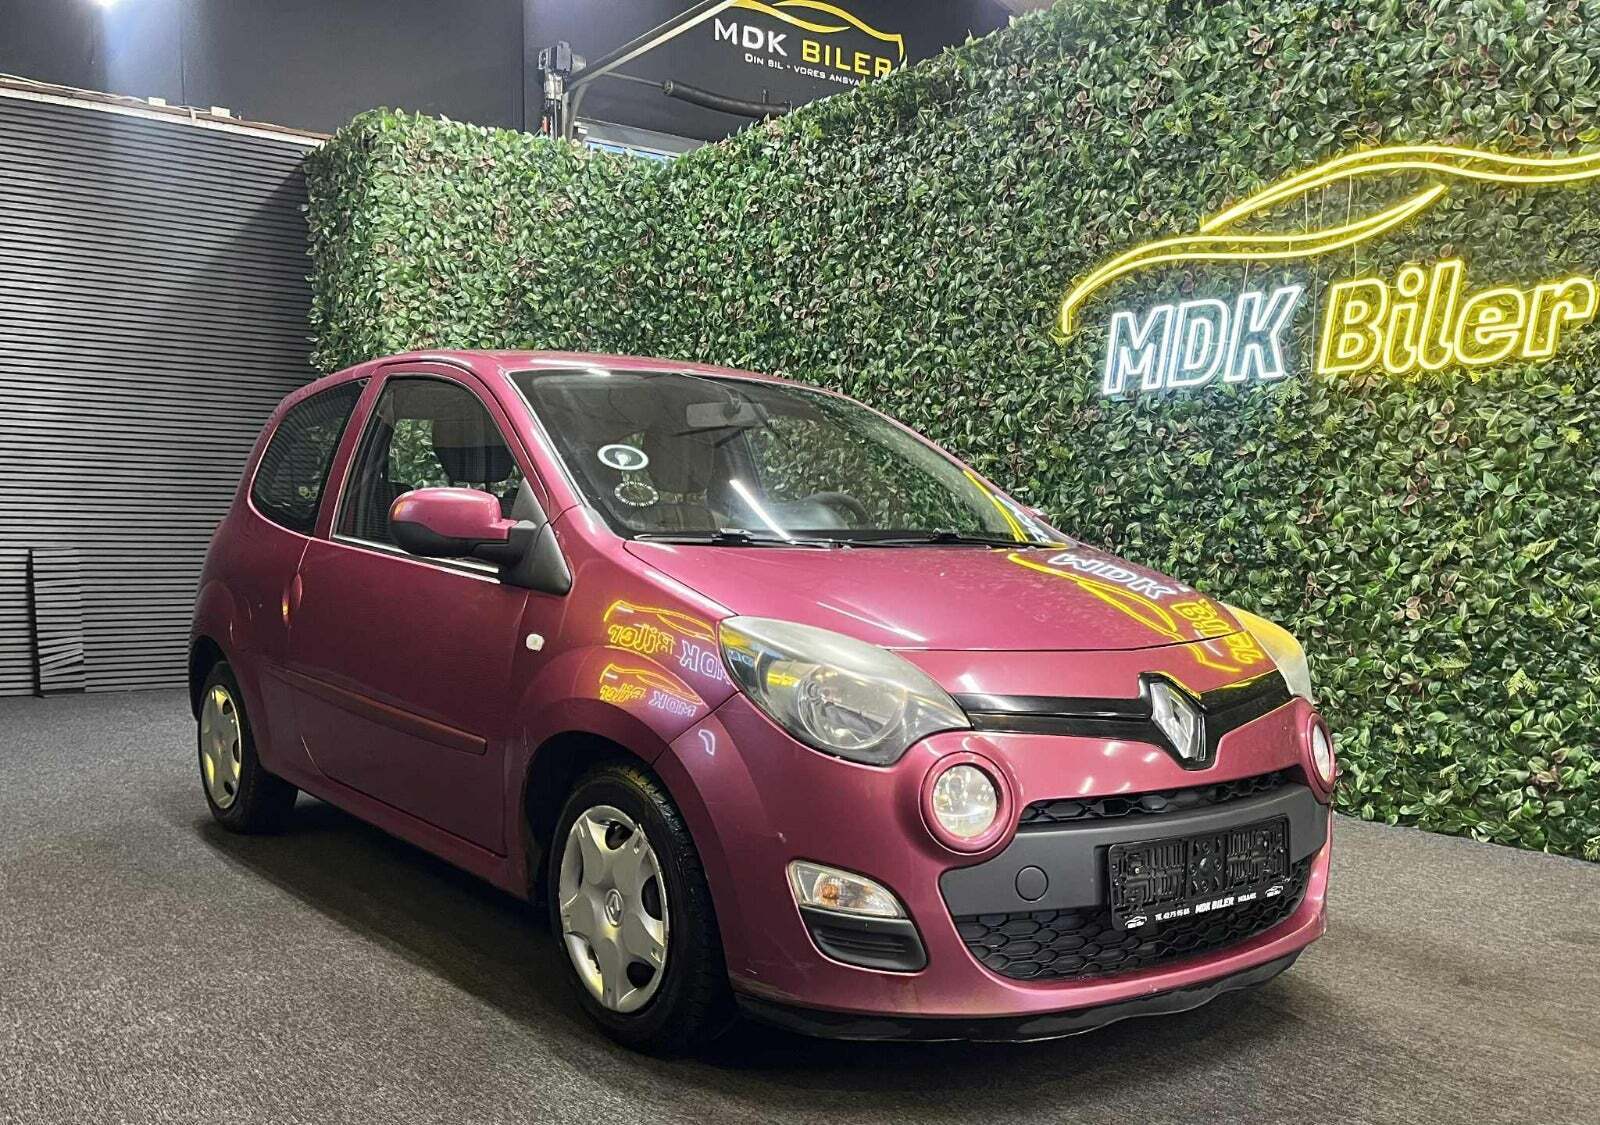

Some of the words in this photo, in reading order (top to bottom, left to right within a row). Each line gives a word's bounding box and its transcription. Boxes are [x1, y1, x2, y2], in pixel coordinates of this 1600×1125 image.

[714, 18, 788, 57] MDK
[802, 39, 892, 78] BILER
[744, 53, 764, 65] DIN
[768, 59, 783, 70] BIL
[794, 65, 826, 79] VORES
[829, 74, 860, 87] ANSVA
[1102, 284, 1304, 396] MDK
[1316, 257, 1599, 376] Biler
